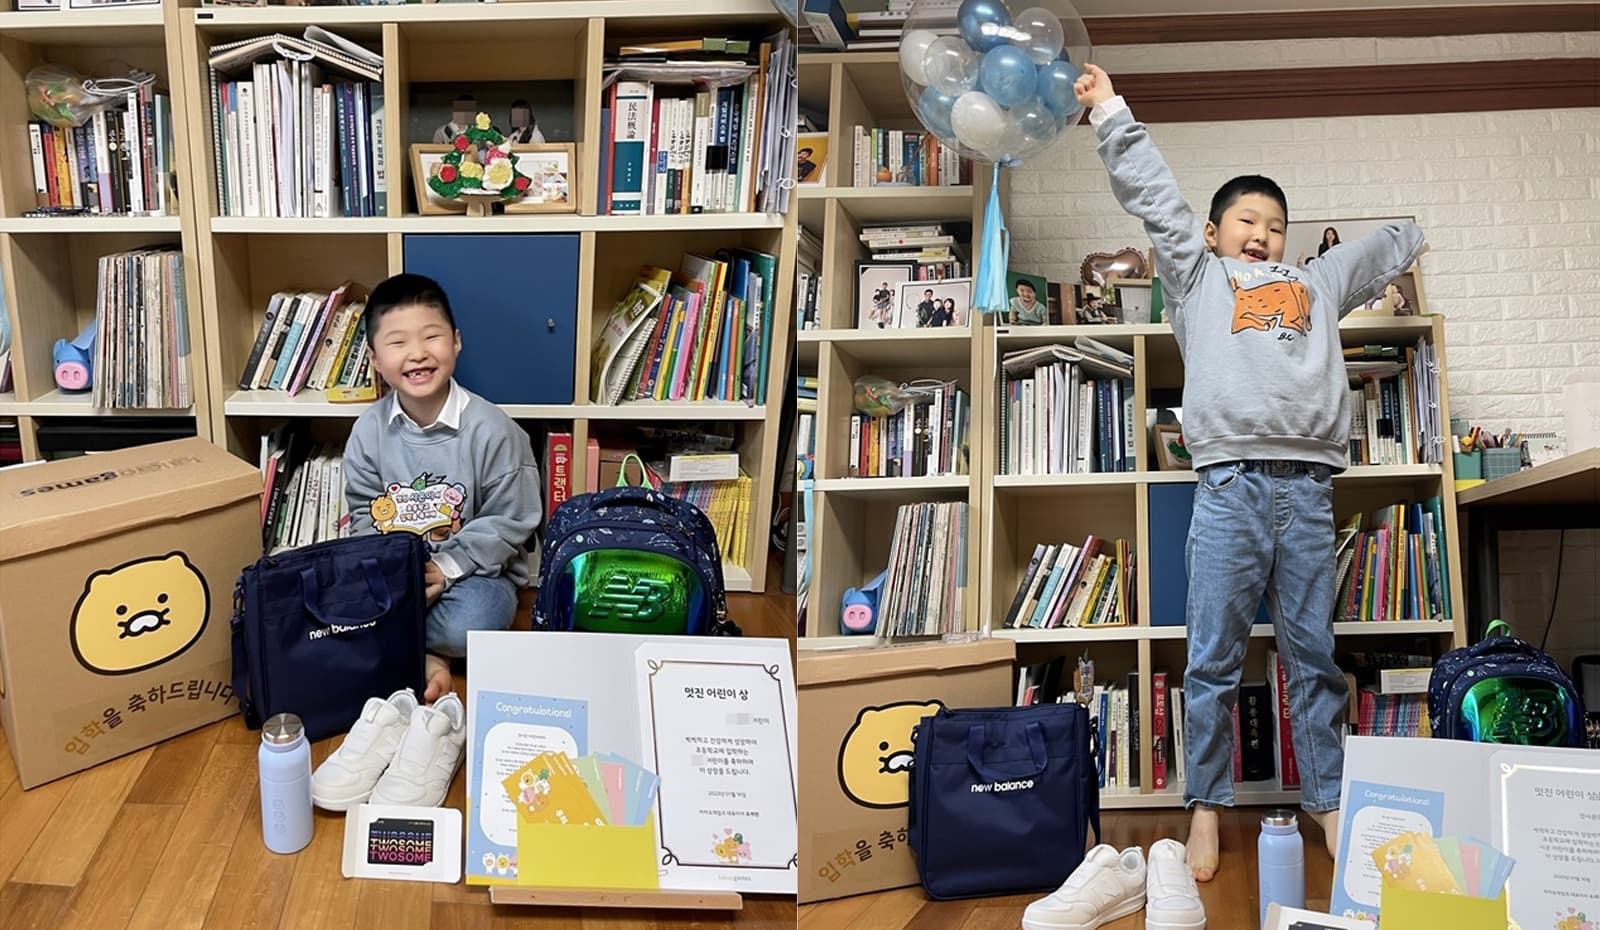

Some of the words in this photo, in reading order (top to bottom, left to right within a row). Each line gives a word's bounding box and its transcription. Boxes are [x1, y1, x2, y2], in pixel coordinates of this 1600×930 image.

[684, 687, 704, 699] 멋진
[706, 688, 737, 700] 어린이
[738, 689, 749, 701] 상
[64, 707, 123, 755] 입학을
[970, 783, 993, 793] new
[994, 780, 1034, 792] balance
[1534, 786, 1553, 798] 멋진
[1555, 787, 1585, 799] 어린이
[369, 851, 432, 863] TWOSOME
[818, 840, 873, 883] 입학을
